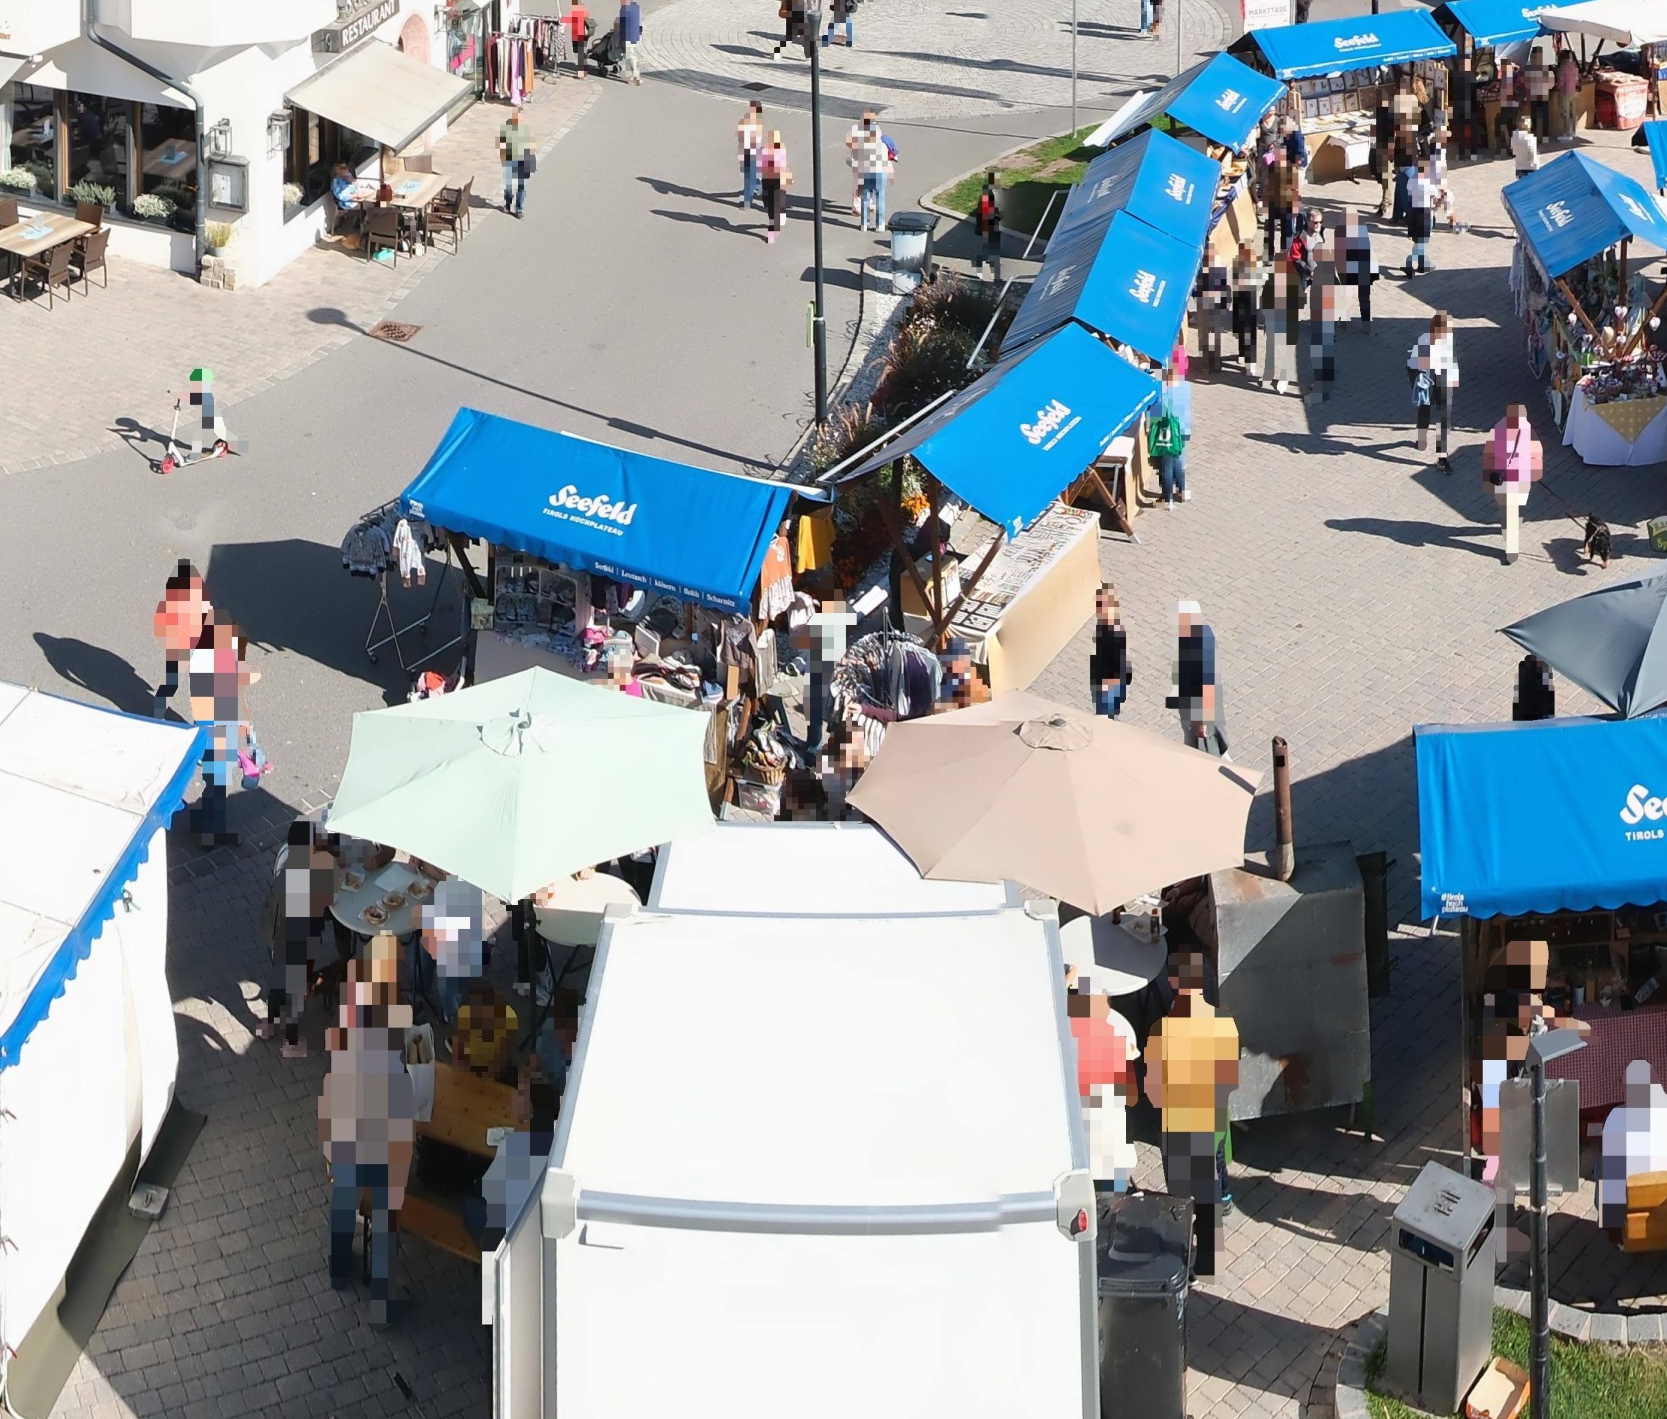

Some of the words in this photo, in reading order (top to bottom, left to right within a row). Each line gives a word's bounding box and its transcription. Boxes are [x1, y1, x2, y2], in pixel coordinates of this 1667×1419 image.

[1020, 398, 1072, 445] Seefeld
[542, 507, 568, 520] TIROLS
[569, 514, 624, 536] HOCHPLATEAU
[548, 485, 638, 526] Seefeld
[1624, 827, 1664, 842] TIROLS
